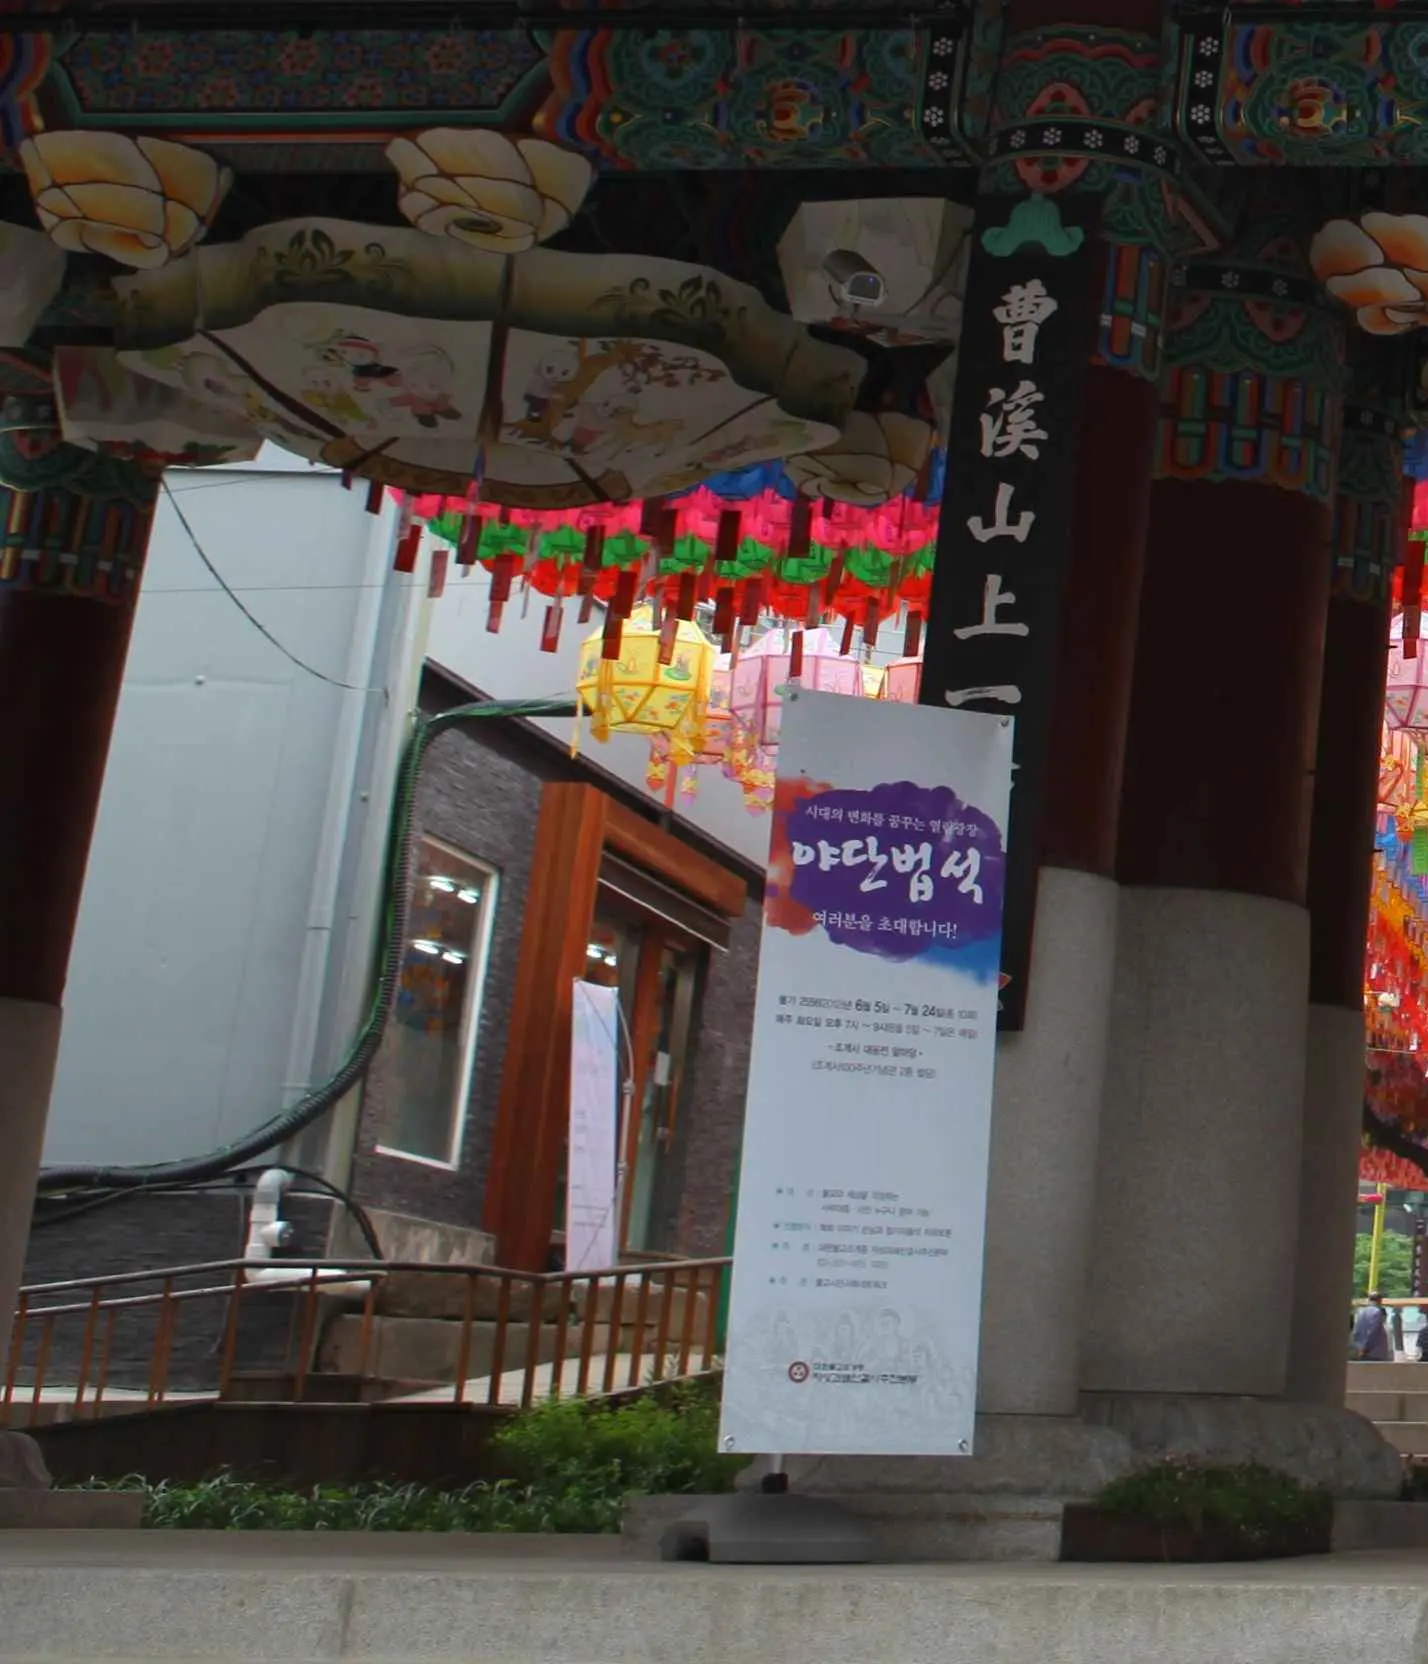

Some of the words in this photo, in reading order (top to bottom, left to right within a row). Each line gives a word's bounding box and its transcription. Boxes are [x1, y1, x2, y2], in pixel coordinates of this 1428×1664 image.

[943, 278, 1058, 851] 曹溪山上一
[805, 805, 843, 822] 시대의
[848, 809, 885, 827] 변화를
[888, 814, 926, 832] 꿈꾸는
[792, 836, 984, 905] 야단법석
[812, 910, 874, 932] 여러분을
[878, 916, 958, 939] 초대합니다!
[855, 999, 870, 1012] 6월
[874, 1001, 890, 1014] 5일
[904, 1003, 919, 1016] 7월
[825, 1017, 842, 1028] 오후
